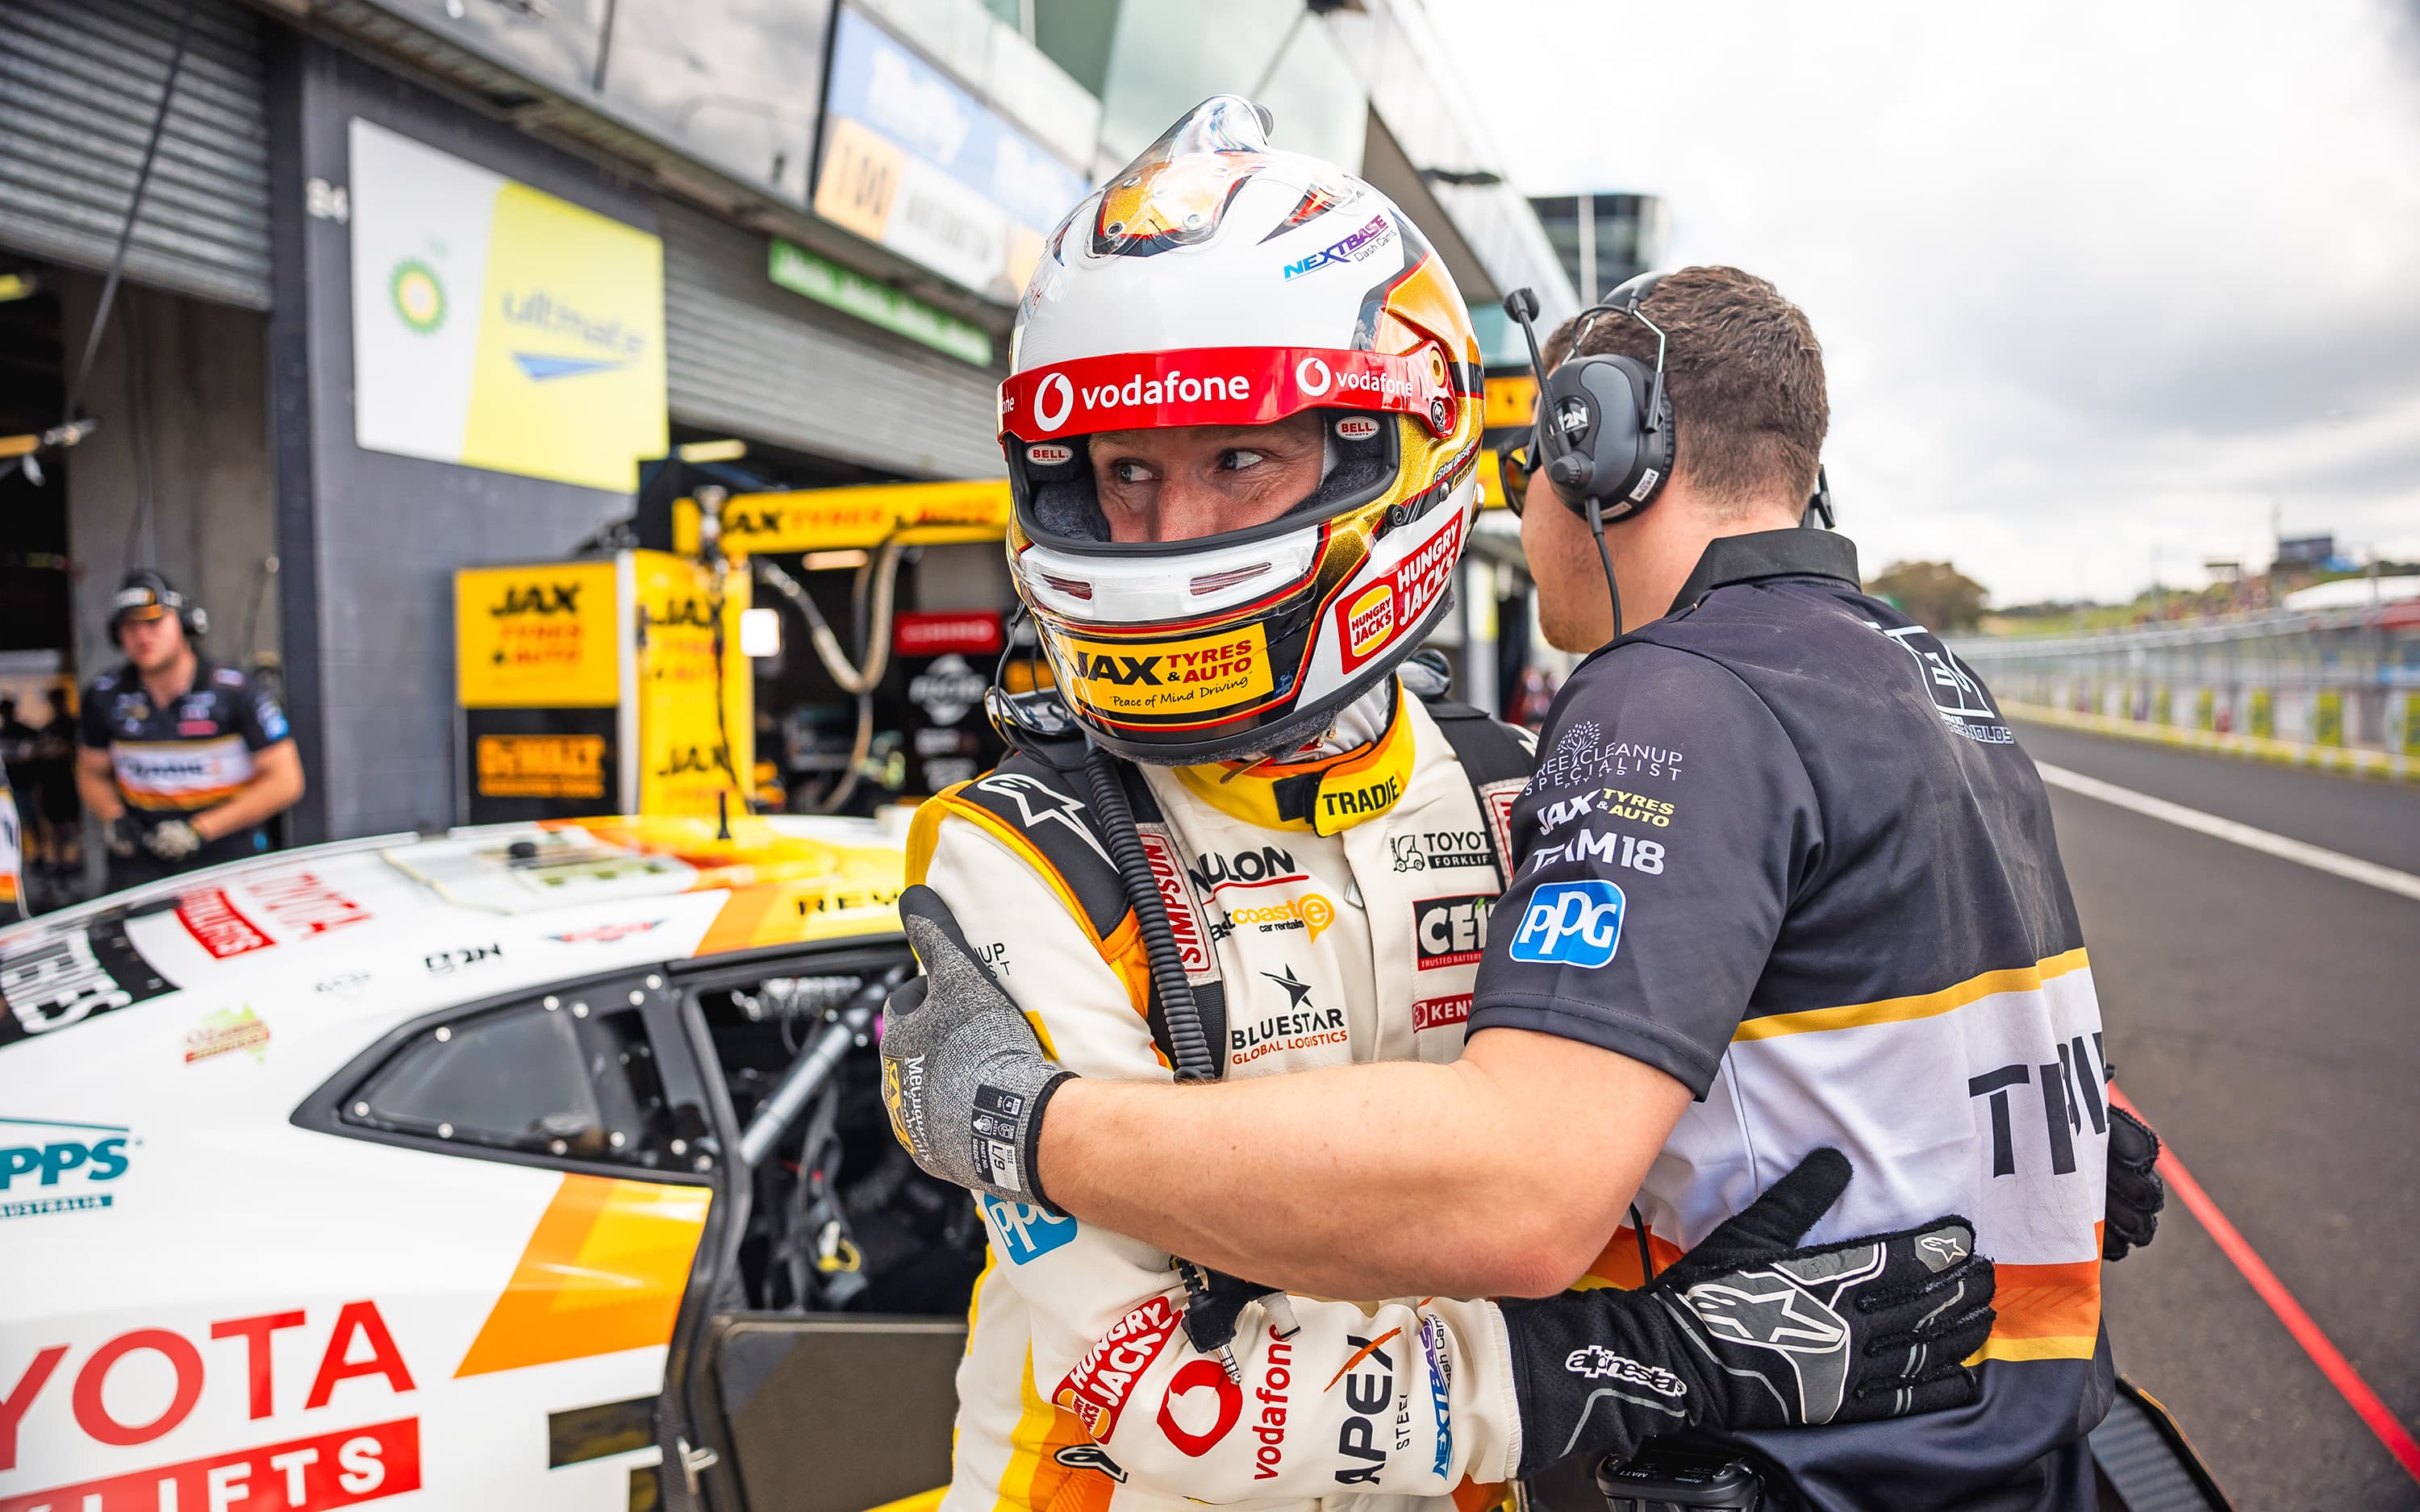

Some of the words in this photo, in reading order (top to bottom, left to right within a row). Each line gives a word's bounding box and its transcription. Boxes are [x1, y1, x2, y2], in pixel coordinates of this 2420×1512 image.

[1283, 215, 1387, 280] NEXTBASE
[1354, 244, 1378, 262] Dash
[1376, 229, 1397, 248] Cams
[1082, 371, 1250, 410] vodafone
[1335, 369, 1413, 397] vodafone
[1341, 423, 1374, 433] BELL
[1033, 449, 1066, 459] BELL
[1397, 519, 1459, 593] HUNGRY
[490, 584, 581, 616] JAX
[1400, 546, 1455, 626] JACK'S
[1352, 598, 1391, 631] HUNGRY
[1354, 610, 1392, 646] JACK'S
[1077, 651, 1163, 686] JAX
[1166, 639, 1252, 669] TYRES
[1167, 671, 1180, 682] &
[1183, 656, 1252, 684] AUTO
[1145, 694, 1158, 708] of
[1160, 690, 1194, 704] Mind
[1579, 742, 1684, 766] CLEANUP
[1525, 756, 1682, 797] SPECIALIST
[1564, 777, 1589, 789] PTY
[1598, 767, 1626, 777] LTD
[1322, 776, 1400, 816] TRADIE
[1537, 788, 1601, 836] JAX
[1602, 787, 1675, 816] TYRES
[1596, 800, 1609, 811] &
[1608, 804, 1671, 828] AUTO
[1434, 853, 1492, 867] FORKLIF
[1258, 923, 1273, 934] car
[1274, 918, 1305, 932] rentals
[1517, 890, 1617, 955] PPG
[974, 943, 1005, 964] UP
[1421, 956, 1452, 968] TRUSTED
[1231, 1008, 1346, 1050] BLUESTAR
[1232, 1040, 1283, 1065] GLOBAL
[1287, 1030, 1348, 1049] LOGISTICS
[991, 1144, 1006, 1171] L/9
[1070, 1302, 1162, 1390] HUNGRY
[1331, 1328, 1397, 1485] APEX
[1420, 1316, 1453, 1481] NEXTBAS
[36, 1436, 386, 1512] IFTS
